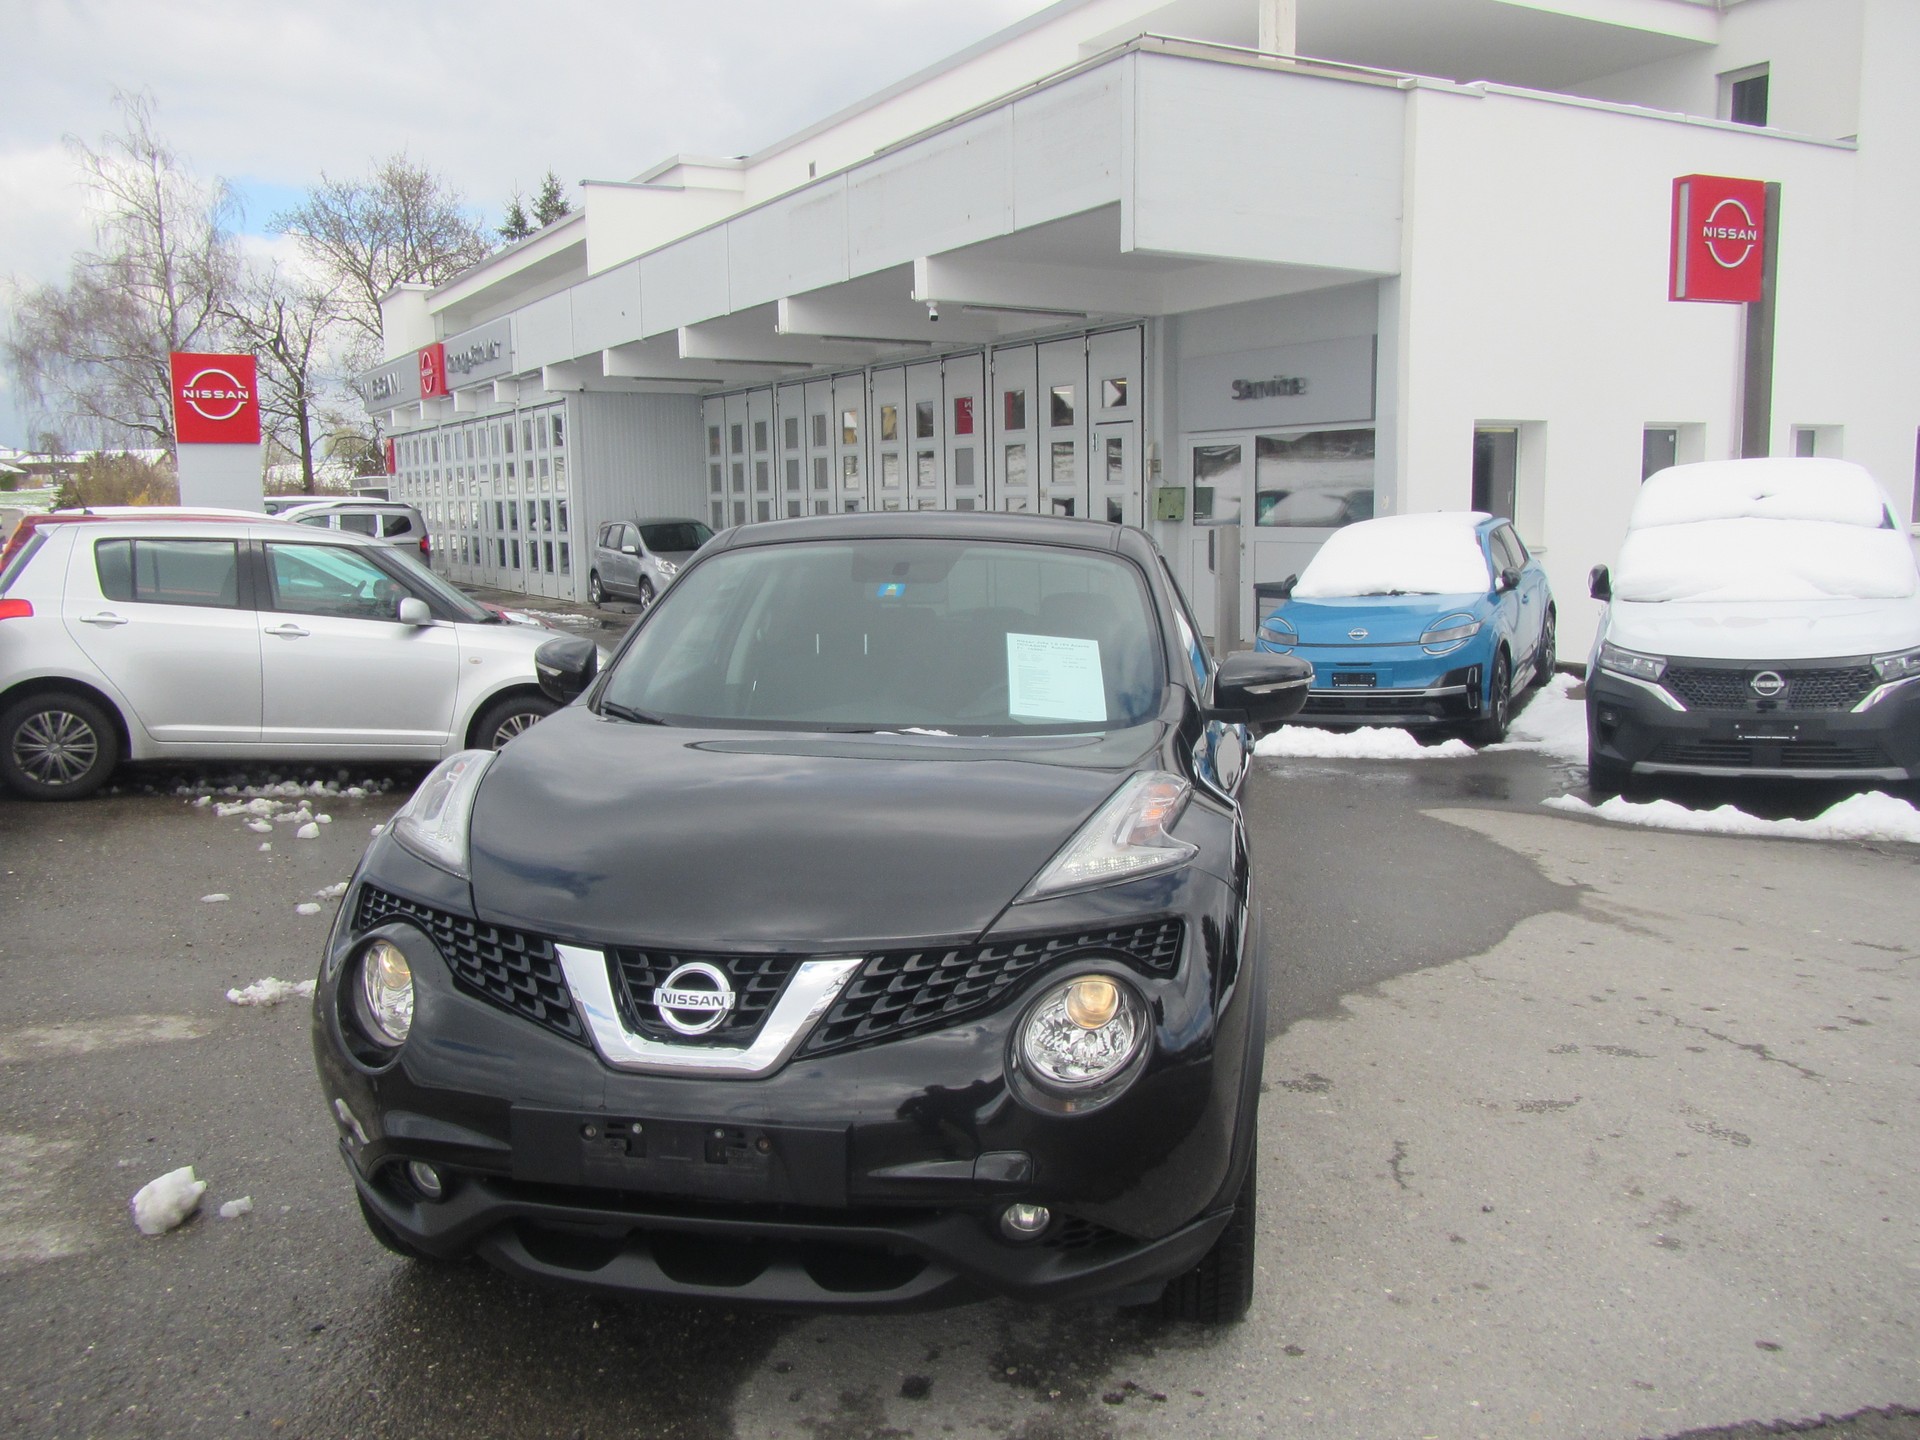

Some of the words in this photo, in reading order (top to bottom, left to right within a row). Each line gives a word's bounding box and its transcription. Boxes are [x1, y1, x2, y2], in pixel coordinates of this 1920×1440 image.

[1703, 227, 1757, 240] NISSAN
[182, 389, 249, 399] NISSAN
[660, 993, 725, 1007] NISSAN
